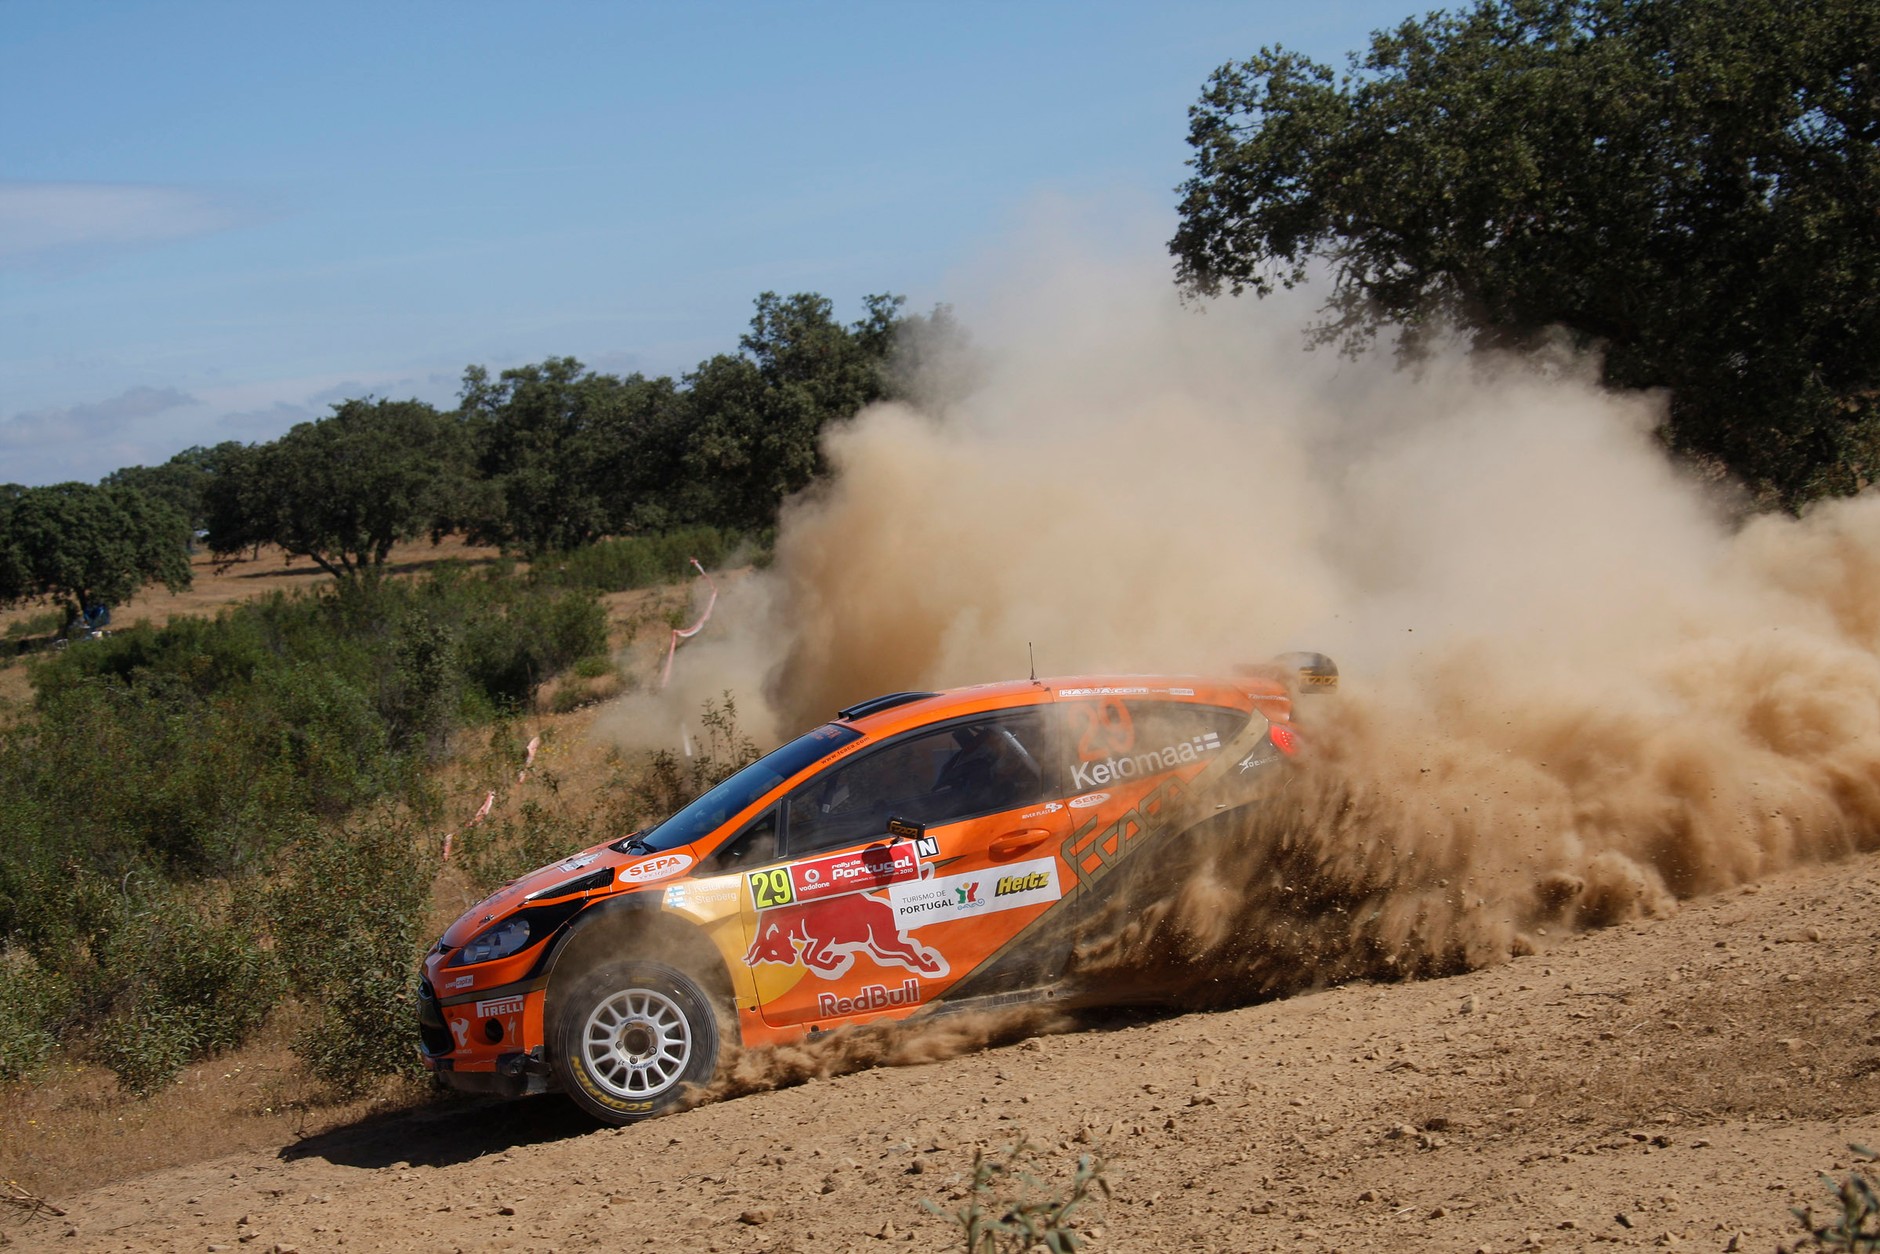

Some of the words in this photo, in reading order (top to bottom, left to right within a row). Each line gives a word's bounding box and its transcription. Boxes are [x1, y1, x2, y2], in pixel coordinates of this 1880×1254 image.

[1068, 696, 1136, 762] 29
[1070, 742, 1197, 790] Ketomaa
[1074, 794, 1104, 806] SEPA
[919, 838, 937, 856] N
[629, 856, 681, 877] SEPA
[831, 860, 851, 870] rally
[850, 859, 861, 867] de
[832, 855, 914, 881] Portugal
[899, 867, 914, 875] 2010
[751, 869, 792, 909] 29
[799, 881, 830, 892] vodafone
[994, 871, 1051, 898] Hertz
[900, 898, 955, 916] PORTUGAL
[902, 893, 935, 904] TURISMO
[936, 890, 947, 898] DE
[475, 994, 524, 1018] PIRELLI
[570, 1055, 654, 1112] SCORPION
